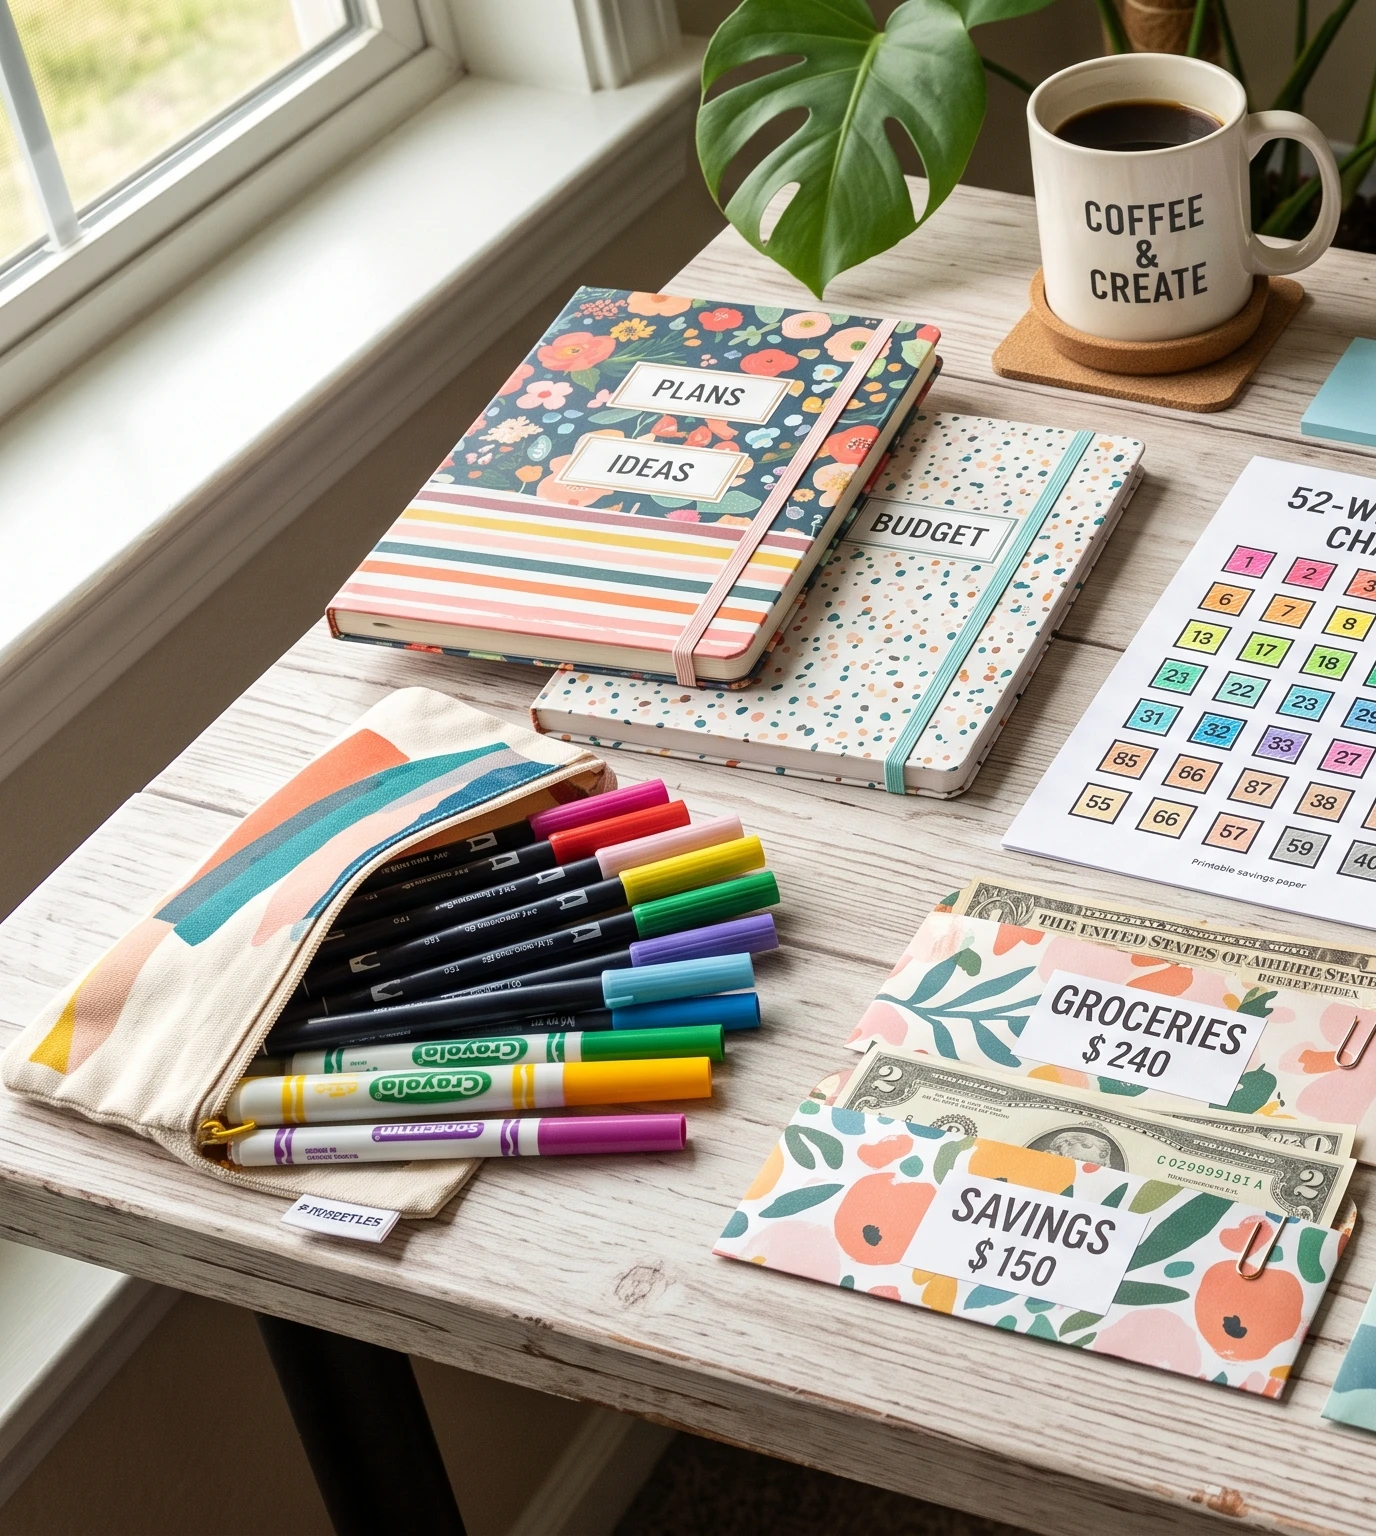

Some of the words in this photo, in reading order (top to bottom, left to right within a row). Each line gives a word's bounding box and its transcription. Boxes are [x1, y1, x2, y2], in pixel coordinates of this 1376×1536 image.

[1085, 193, 1204, 236] COFFEE
[1136, 239, 1159, 269] &
[1090, 262, 1208, 304] CREATE
[650, 378, 747, 408] PLANS
[605, 452, 696, 483] IDEAS
[869, 511, 990, 550] BUDGET
[1245, 556, 1254, 569] 1
[1302, 567, 1317, 580] 2
[1363, 580, 1376, 592] 3
[1219, 593, 1234, 606] 6
[1281, 604, 1296, 617] 7
[1342, 617, 1357, 630] 8
[1192, 629, 1213, 646] 13
[1254, 643, 1278, 657] 17
[1318, 655, 1340, 670] 18
[1163, 668, 1190, 684] 23
[1226, 682, 1255, 699] 22
[1291, 695, 1319, 711] 23
[1139, 709, 1164, 726] 31
[1203, 722, 1231, 739] 32
[1267, 736, 1295, 753] 33
[1333, 750, 1362, 767] 27
[1112, 751, 1141, 768] 85
[1178, 765, 1206, 782] 66
[1244, 779, 1273, 796] 87
[1309, 794, 1338, 811] 38
[1085, 794, 1115, 811] 55
[1152, 809, 1181, 827] 66
[1219, 824, 1248, 841] 57
[1286, 838, 1314, 856] 59
[1191, 858, 1236, 874] Printable
[1237, 867, 1273, 886] savings
[1276, 876, 1307, 889] paper
[1149, 936, 1219, 962] STATES
[1051, 984, 1247, 1055] GROCERIES
[420, 1042, 522, 1065] Crayola
[1081, 1035, 1105, 1065] $
[1107, 1038, 1171, 1078] 240
[380, 1074, 487, 1099] Crayola
[873, 1066, 904, 1099] 2
[1156, 1154, 1167, 1167] C
[1253, 1178, 1263, 1190] A
[1294, 1169, 1325, 1200] 2
[951, 1186, 1117, 1256] SAVINGS
[967, 1238, 993, 1274] $
[997, 1245, 1057, 1288] 150
